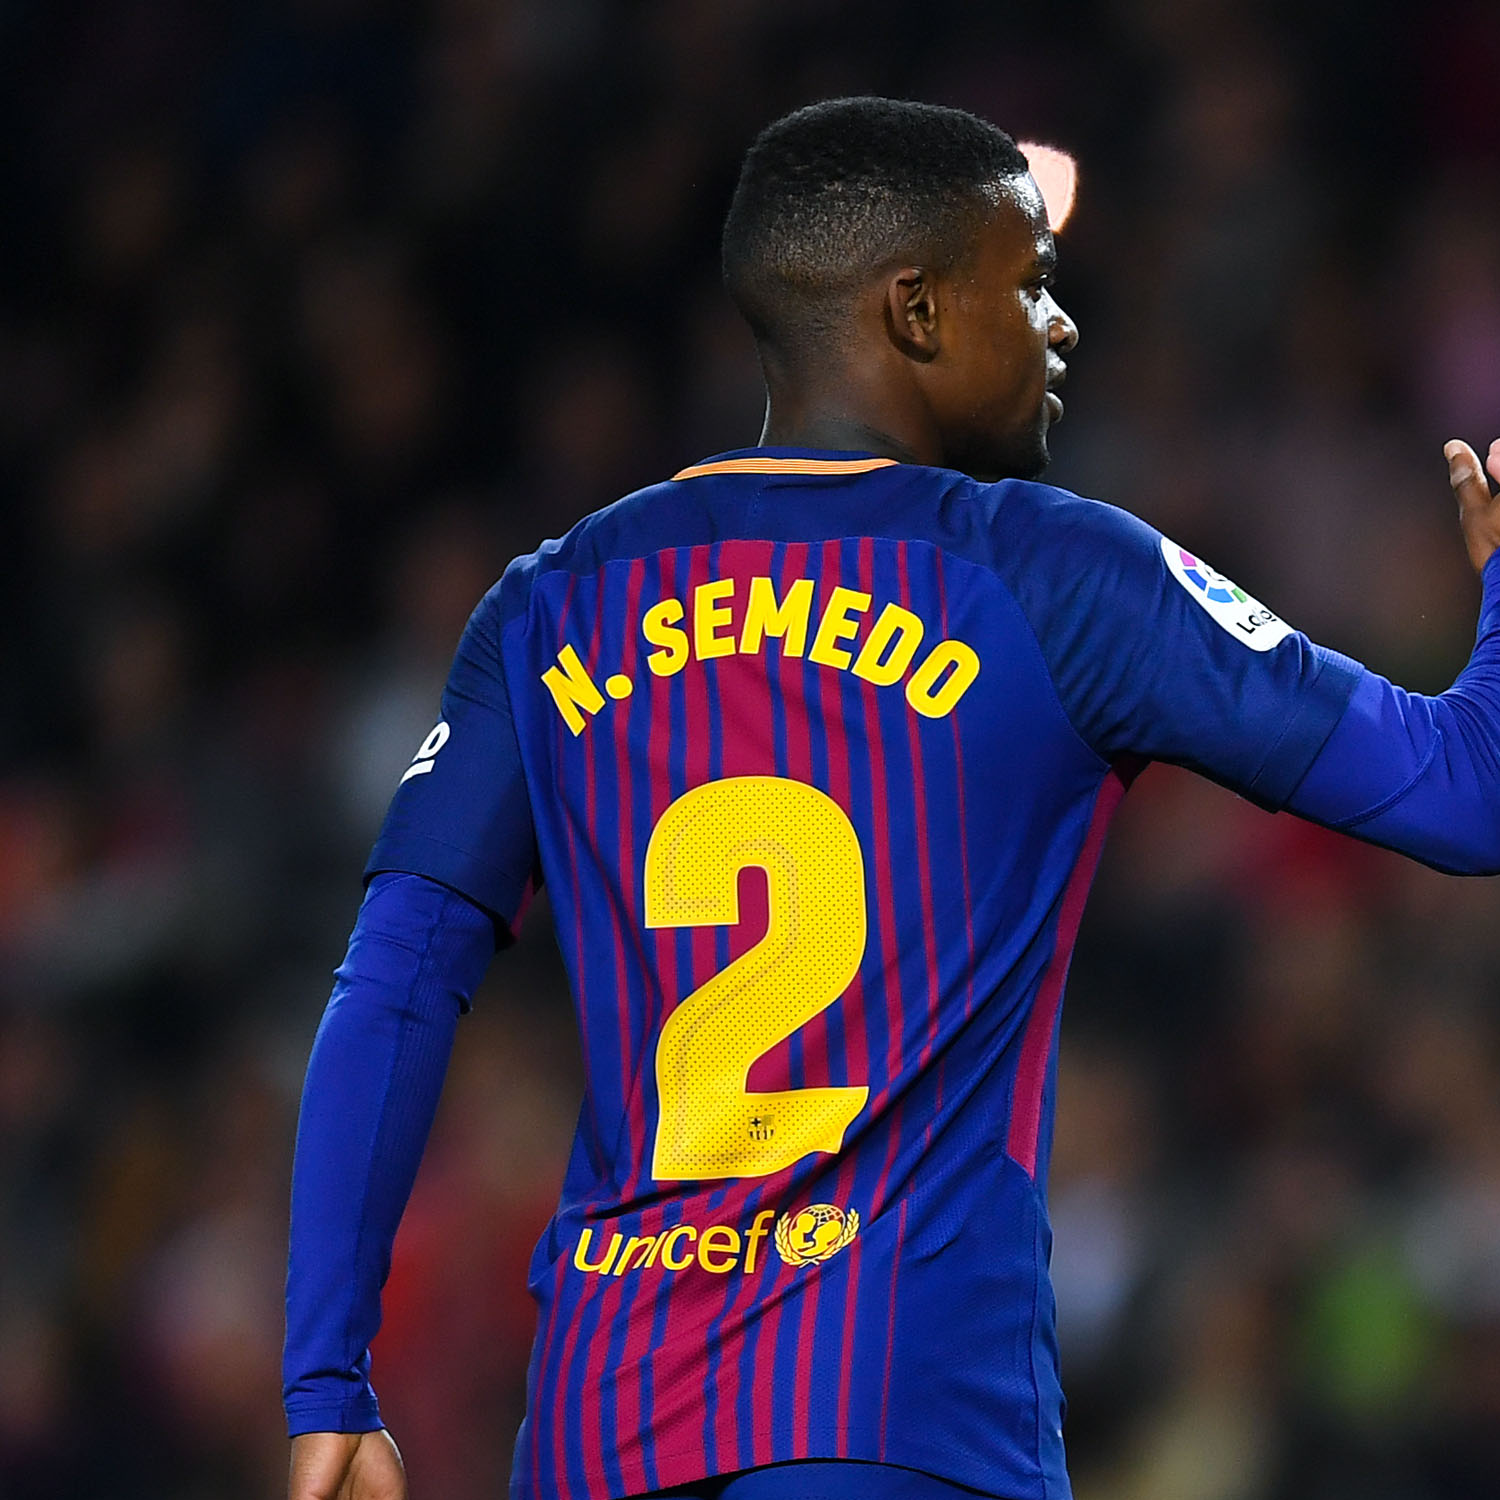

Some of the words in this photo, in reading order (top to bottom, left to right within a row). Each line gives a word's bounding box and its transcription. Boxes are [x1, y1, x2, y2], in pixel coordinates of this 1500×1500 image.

[541, 645, 633, 736] N.
[643, 576, 981, 719] SEMEDO
[645, 776, 869, 1181] 2
[573, 1209, 775, 1277] unicef
